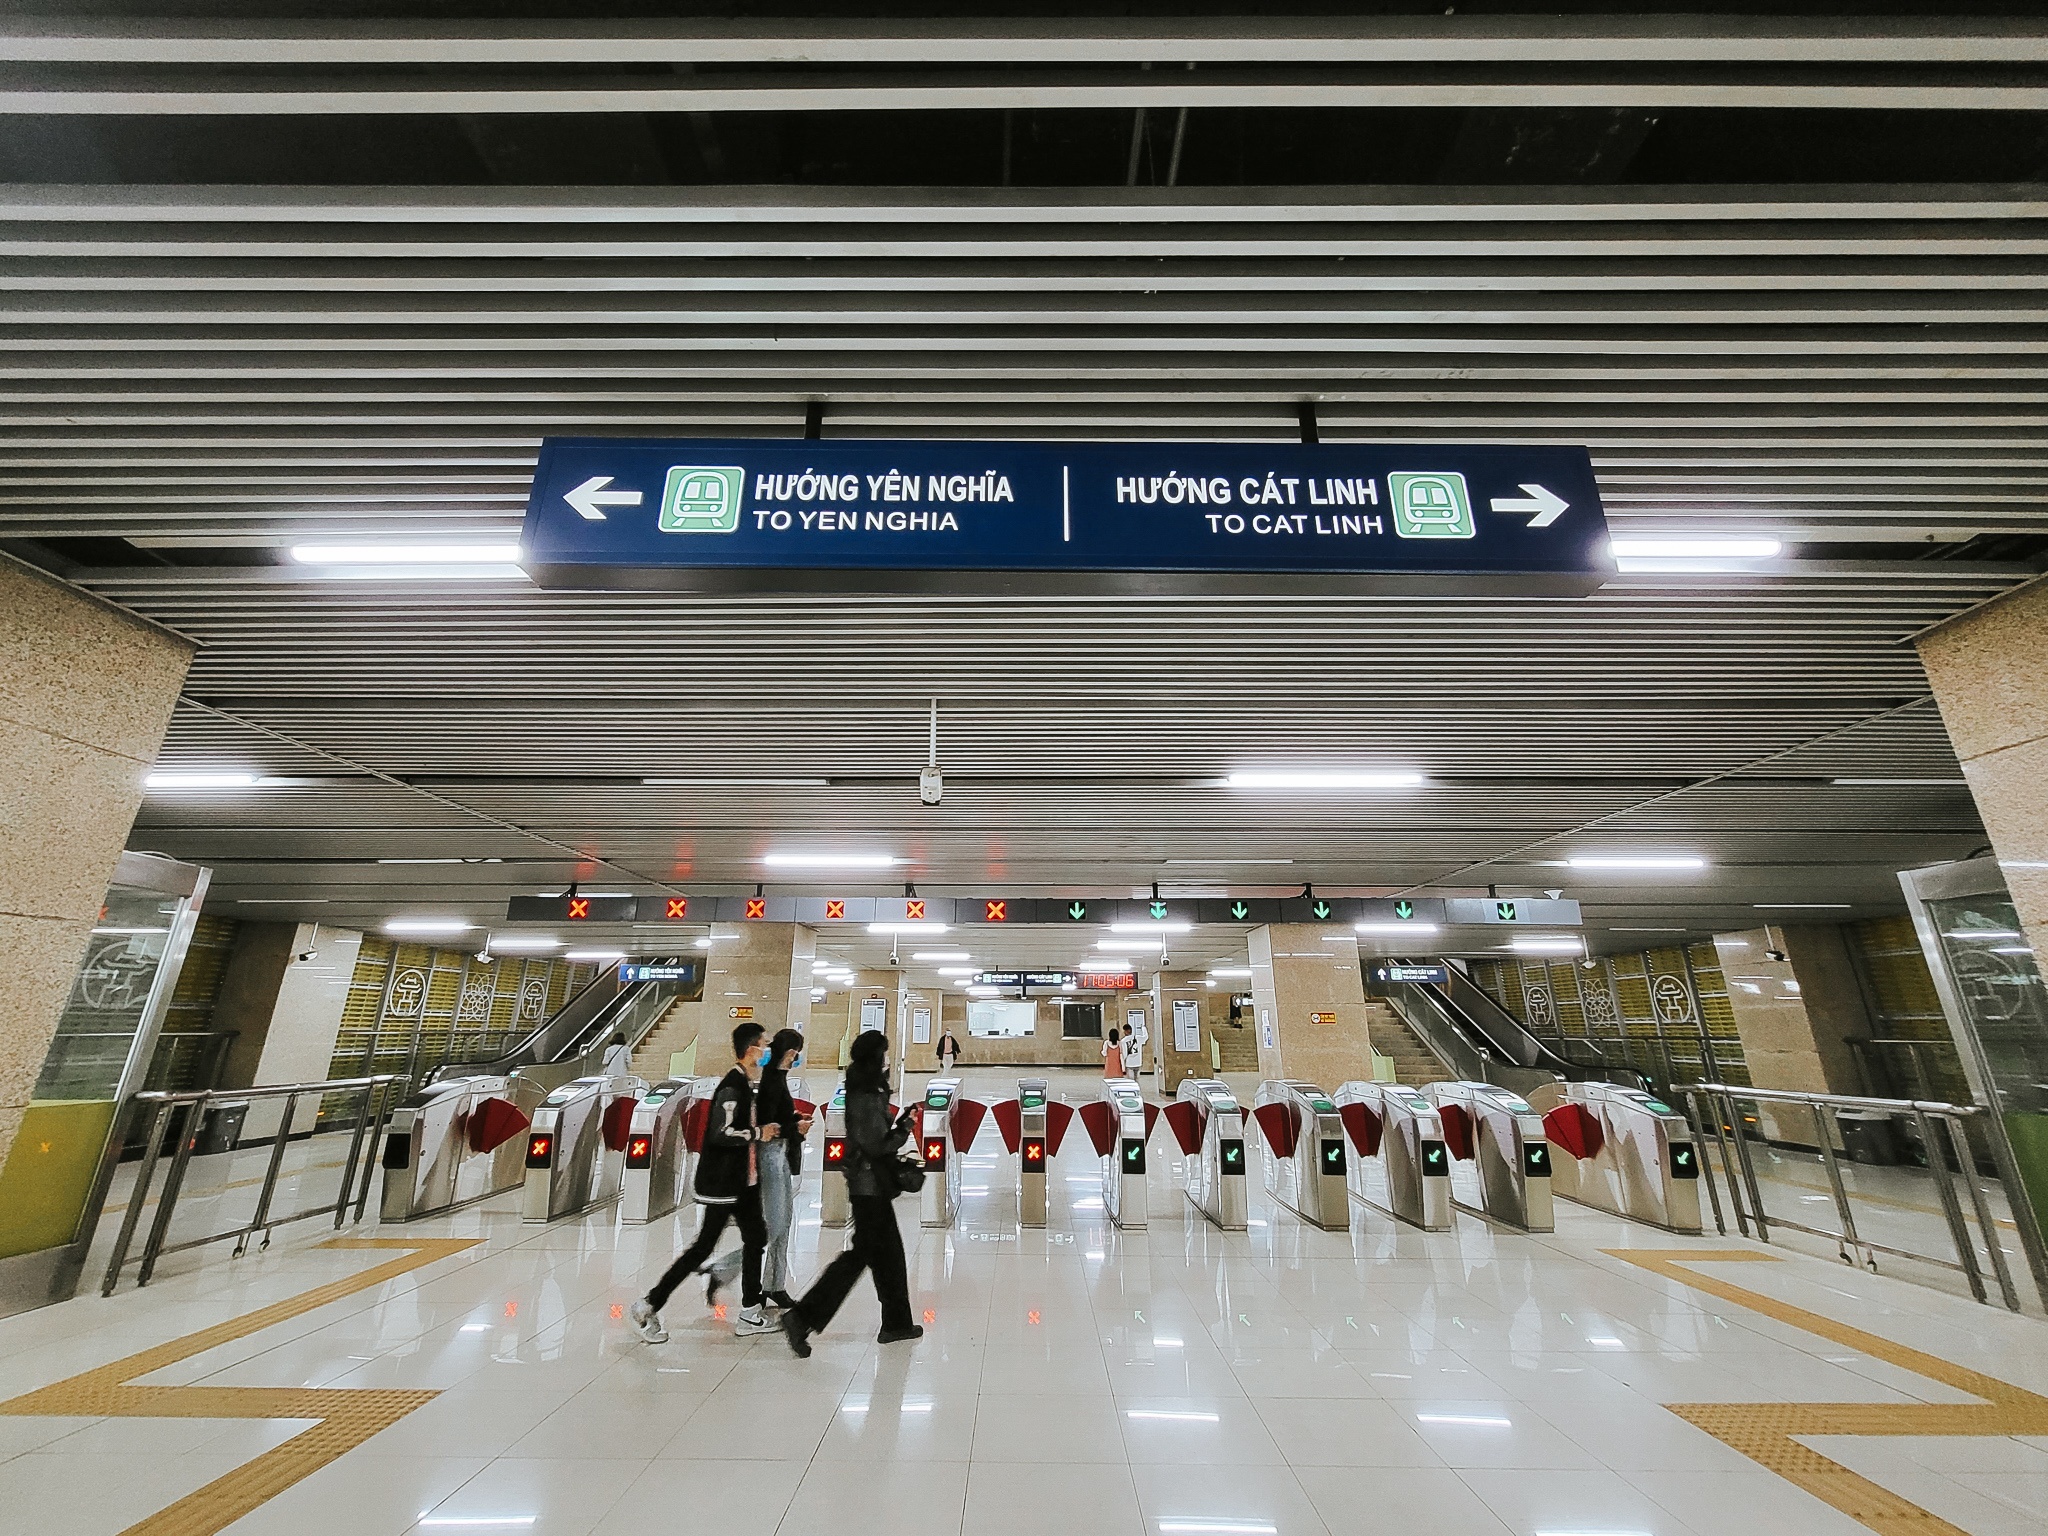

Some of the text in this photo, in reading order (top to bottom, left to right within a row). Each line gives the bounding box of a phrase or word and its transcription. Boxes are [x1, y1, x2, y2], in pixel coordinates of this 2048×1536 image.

[754, 468, 1015, 503] HƯỚNG YÊN NGHĨA
[1116, 471, 1380, 506] HƯỚNG CÁT LINH
[752, 510, 959, 531] TO YEN NGHIA
[1204, 514, 1384, 535] TO CAT LINH
[1083, 973, 1134, 988] 17:05:06
